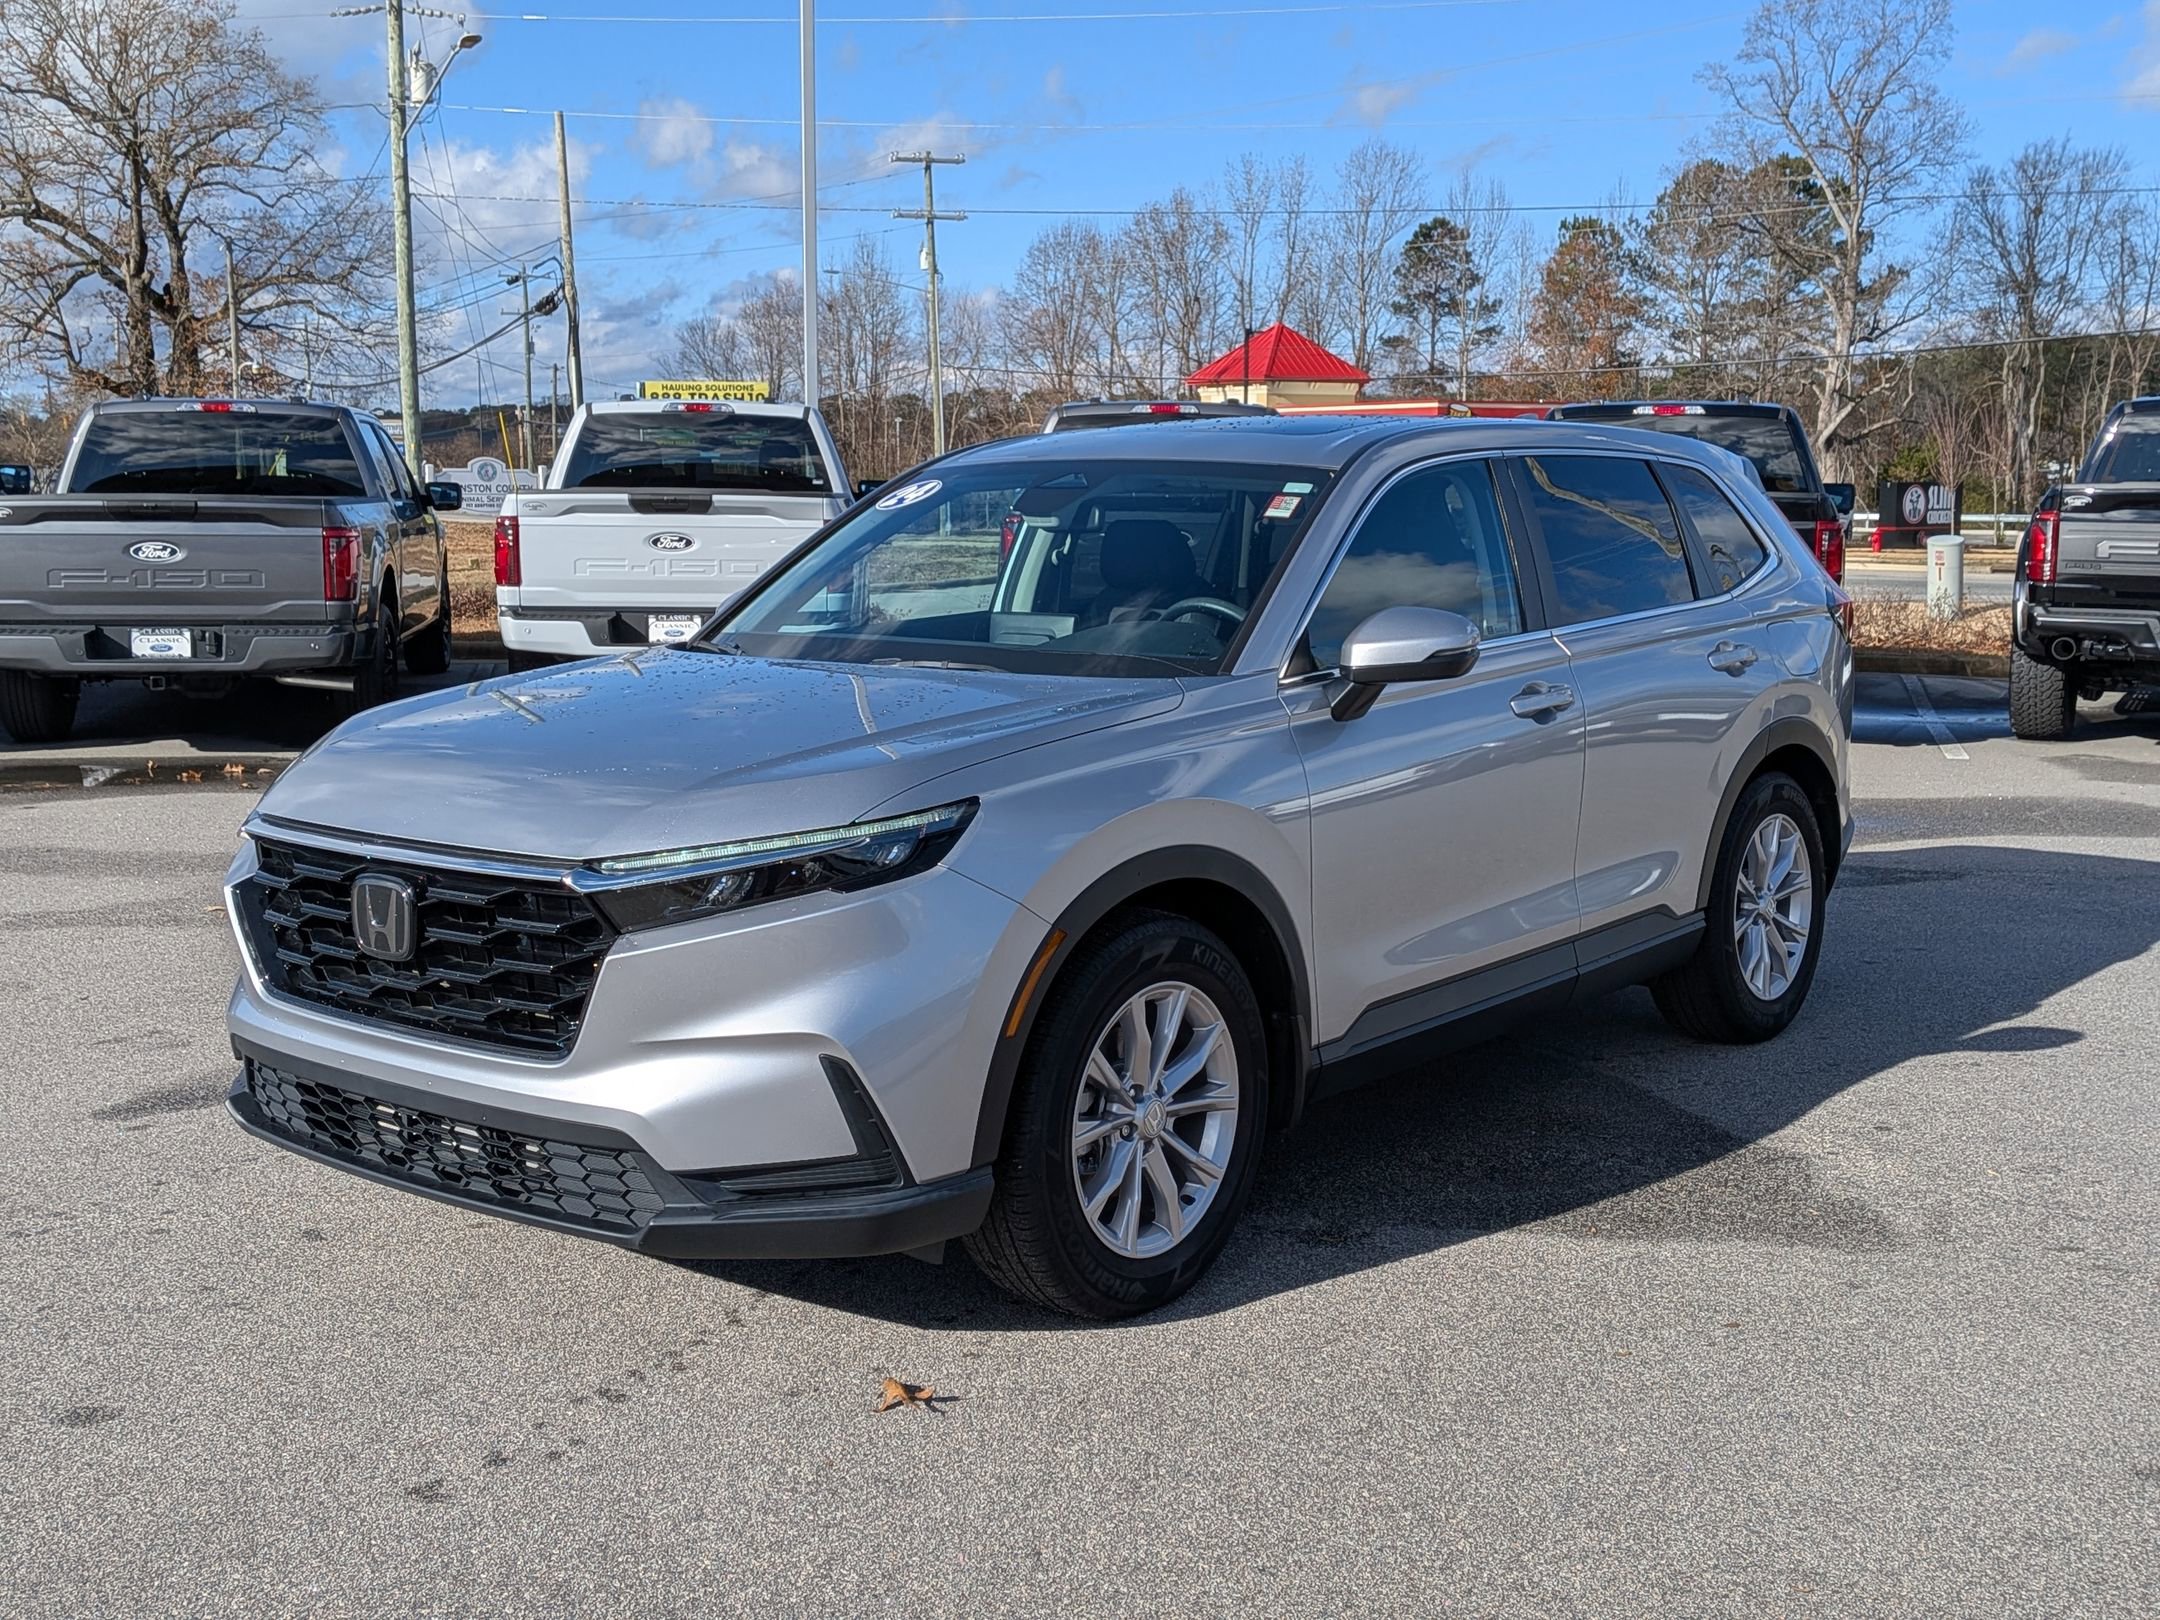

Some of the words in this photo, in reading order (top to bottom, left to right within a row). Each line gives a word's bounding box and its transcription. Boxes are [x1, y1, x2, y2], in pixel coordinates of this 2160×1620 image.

[661, 383, 703, 392] HAULING
[705, 383, 755, 392] SOLUTIONS
[461, 484, 492, 493] NSTON
[656, 534, 686, 549] Ford
[138, 545, 171, 559] Ford
[574, 557, 770, 577] F-150
[46, 568, 265, 588] F-150
